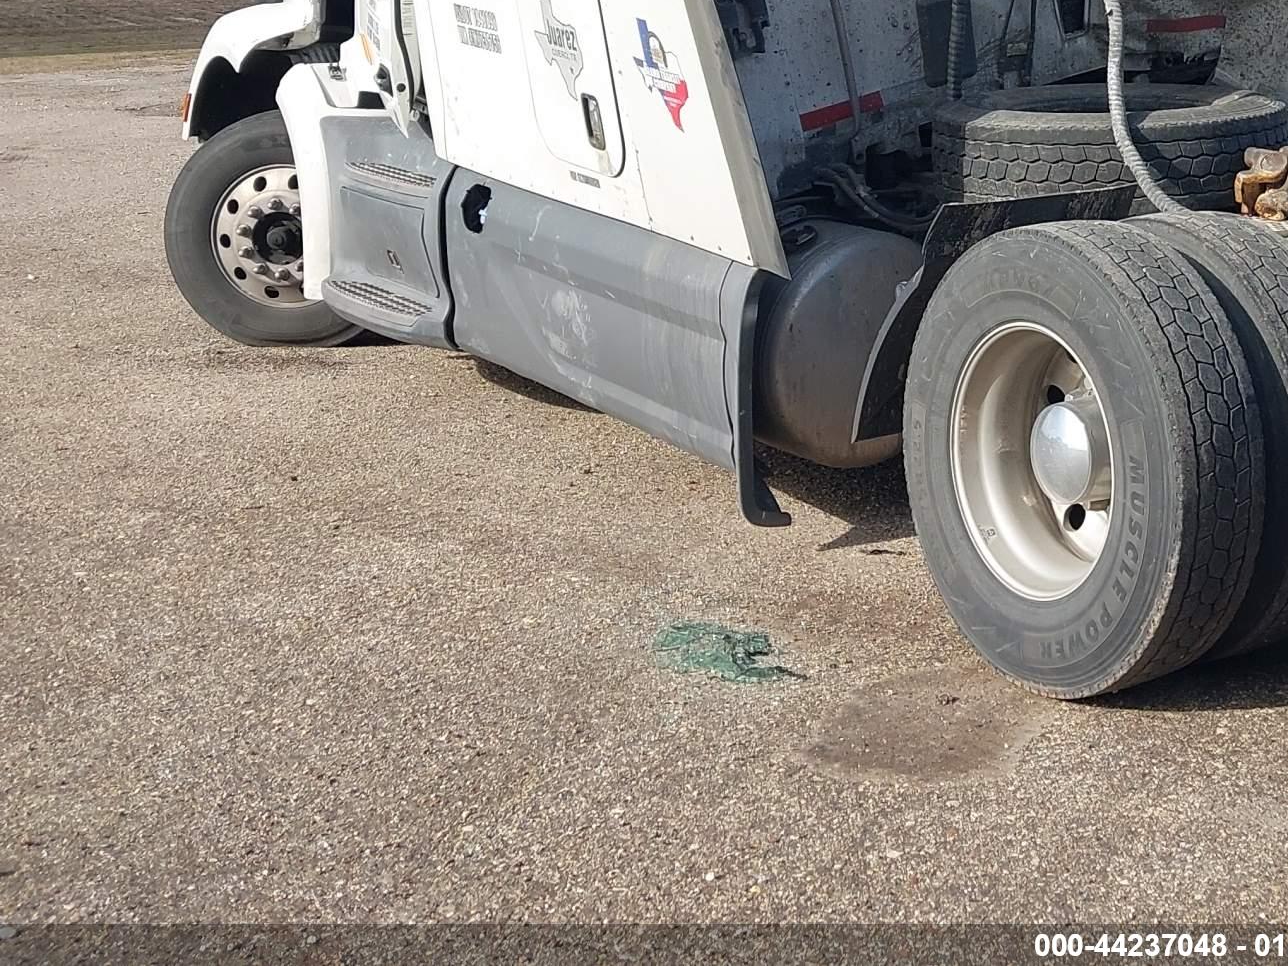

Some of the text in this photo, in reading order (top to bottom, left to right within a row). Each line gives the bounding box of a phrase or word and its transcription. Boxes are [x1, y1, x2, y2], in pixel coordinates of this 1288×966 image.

[546, 19, 577, 51] Juarez
[1040, 455, 1151, 659] MUSCLE POWER
